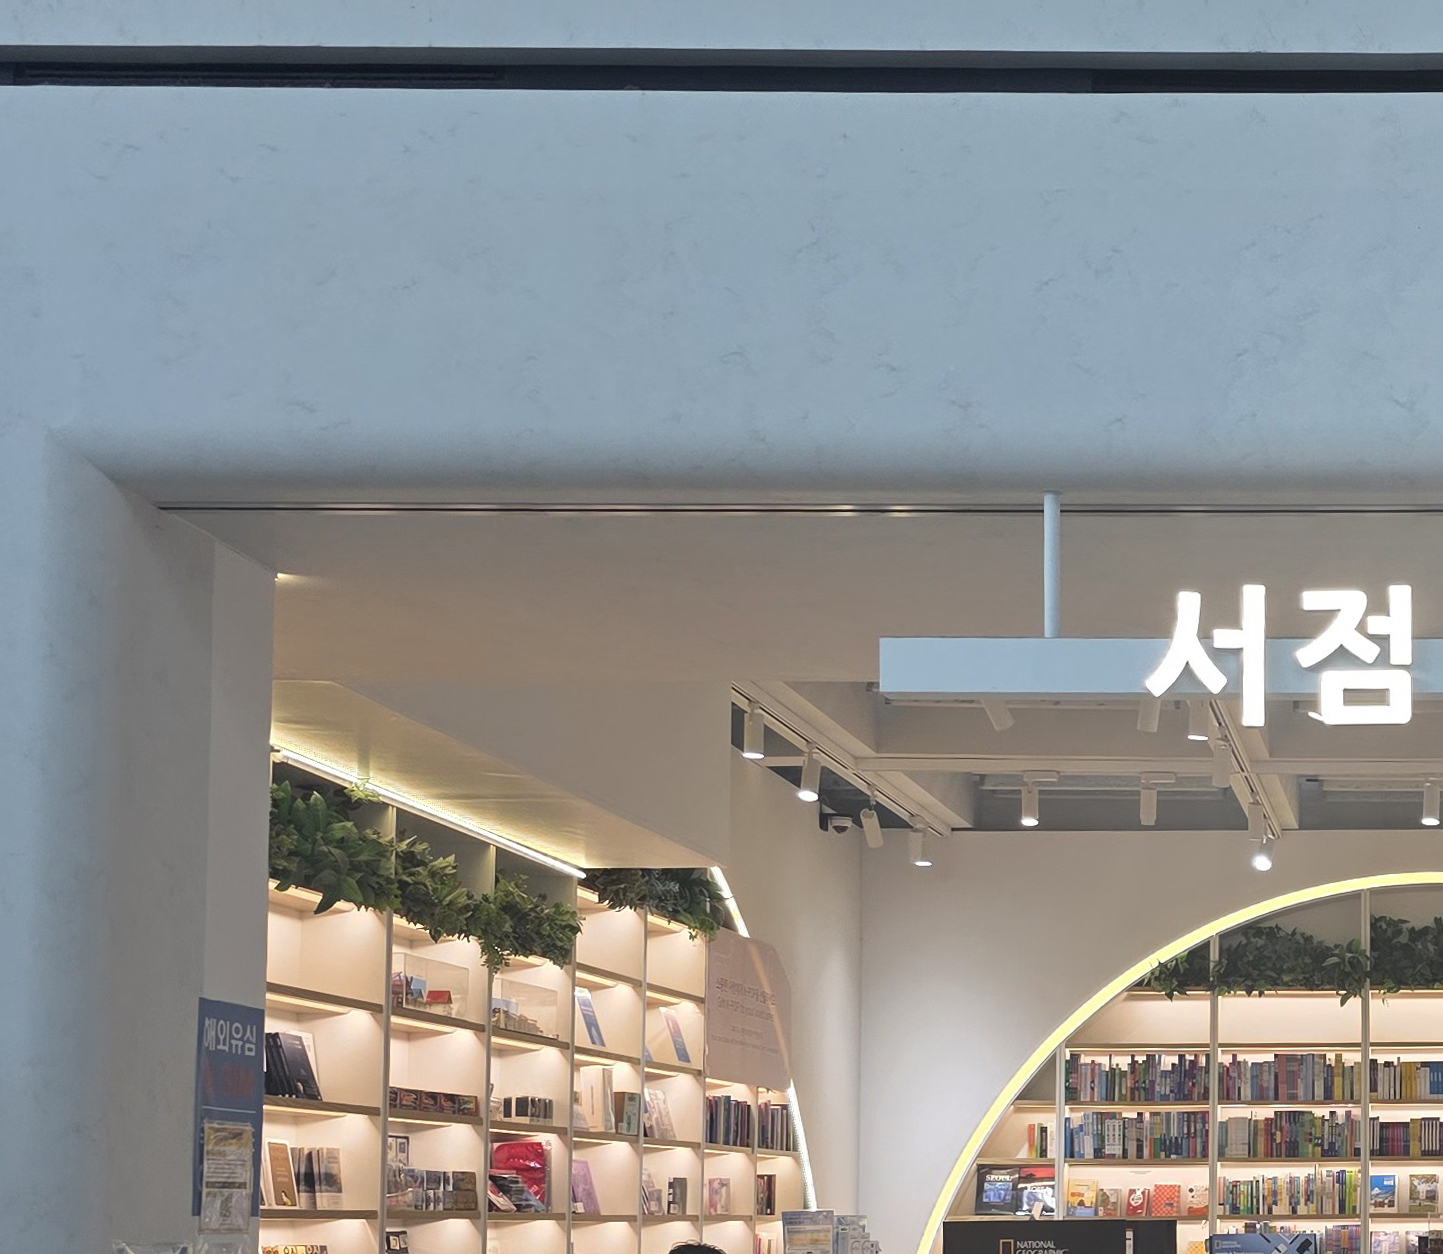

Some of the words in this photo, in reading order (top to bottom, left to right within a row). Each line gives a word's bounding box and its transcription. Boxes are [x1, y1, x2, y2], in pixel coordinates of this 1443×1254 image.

[1145, 584, 1412, 727] 서점
[203, 1017, 256, 1056] 해외유심
[1016, 1240, 1056, 1249] NATIONAL
